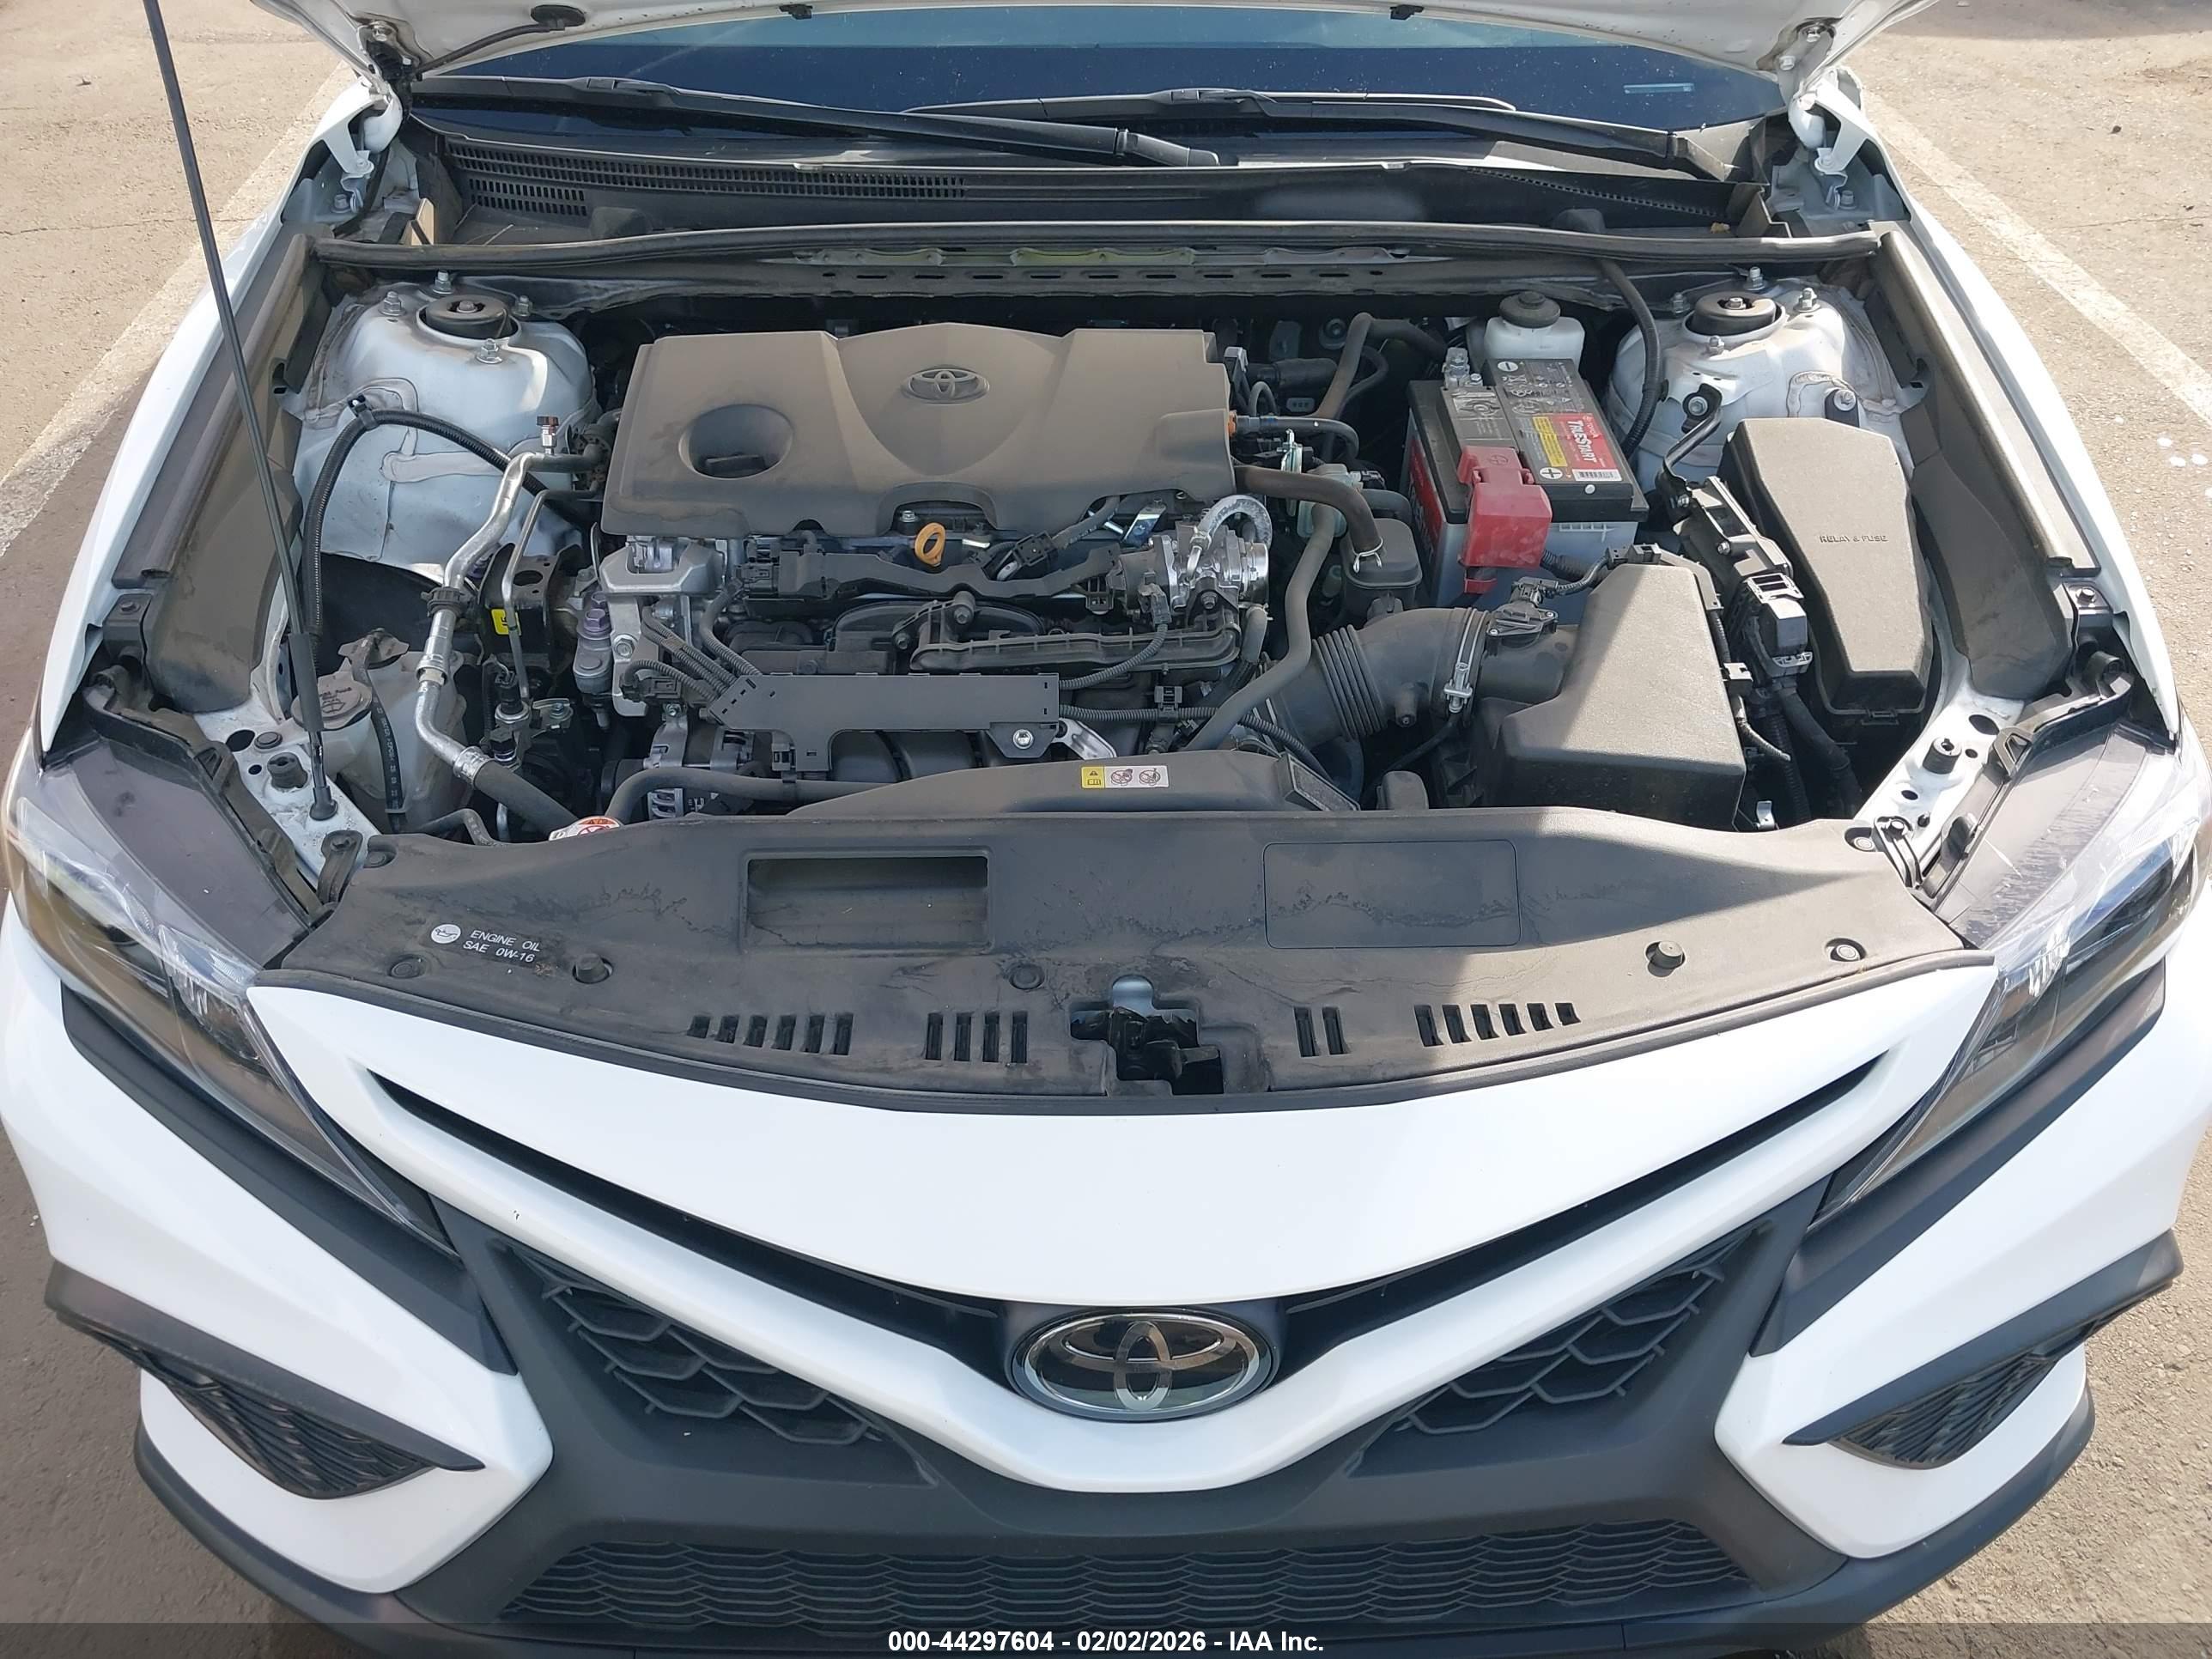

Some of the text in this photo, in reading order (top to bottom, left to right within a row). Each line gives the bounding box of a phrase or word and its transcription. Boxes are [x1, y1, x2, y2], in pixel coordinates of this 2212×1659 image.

[463, 940, 536, 963] SAE 0W-16
[470, 929, 542, 952] ENGINE OIL
